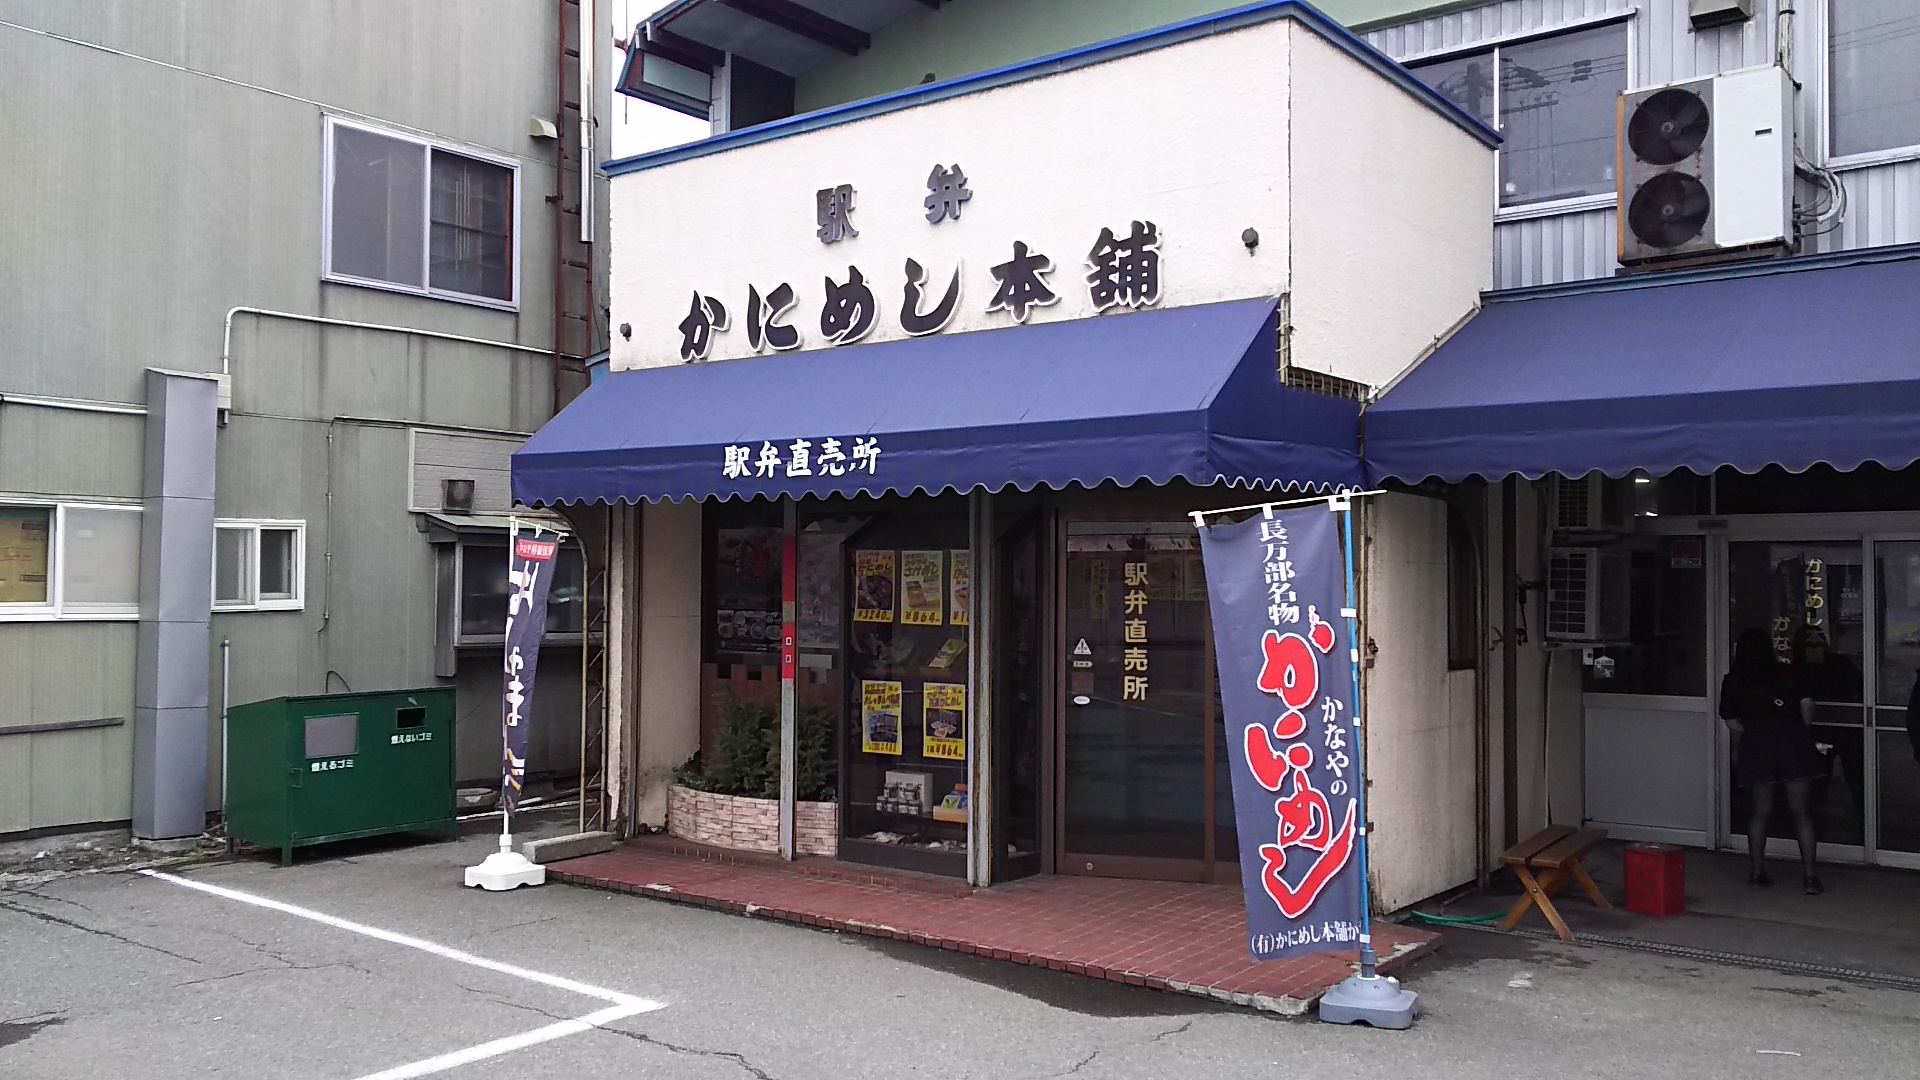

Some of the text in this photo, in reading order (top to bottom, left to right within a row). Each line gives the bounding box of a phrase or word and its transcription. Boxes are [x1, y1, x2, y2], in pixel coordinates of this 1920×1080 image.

[816, 163, 973, 244] 駅弁
[678, 220, 1165, 363] かにめし本舗
[722, 437, 882, 479] 駅弁直売所
[1257, 519, 1300, 625] 長万部名物
[1804, 558, 1825, 663] かにめし本
[1123, 562, 1149, 701] 駅弁直売所
[1244, 604, 1357, 919] かにめし
[1320, 697, 1350, 796] かなやの
[1251, 920, 1361, 954] (有)かにめし本舗か
